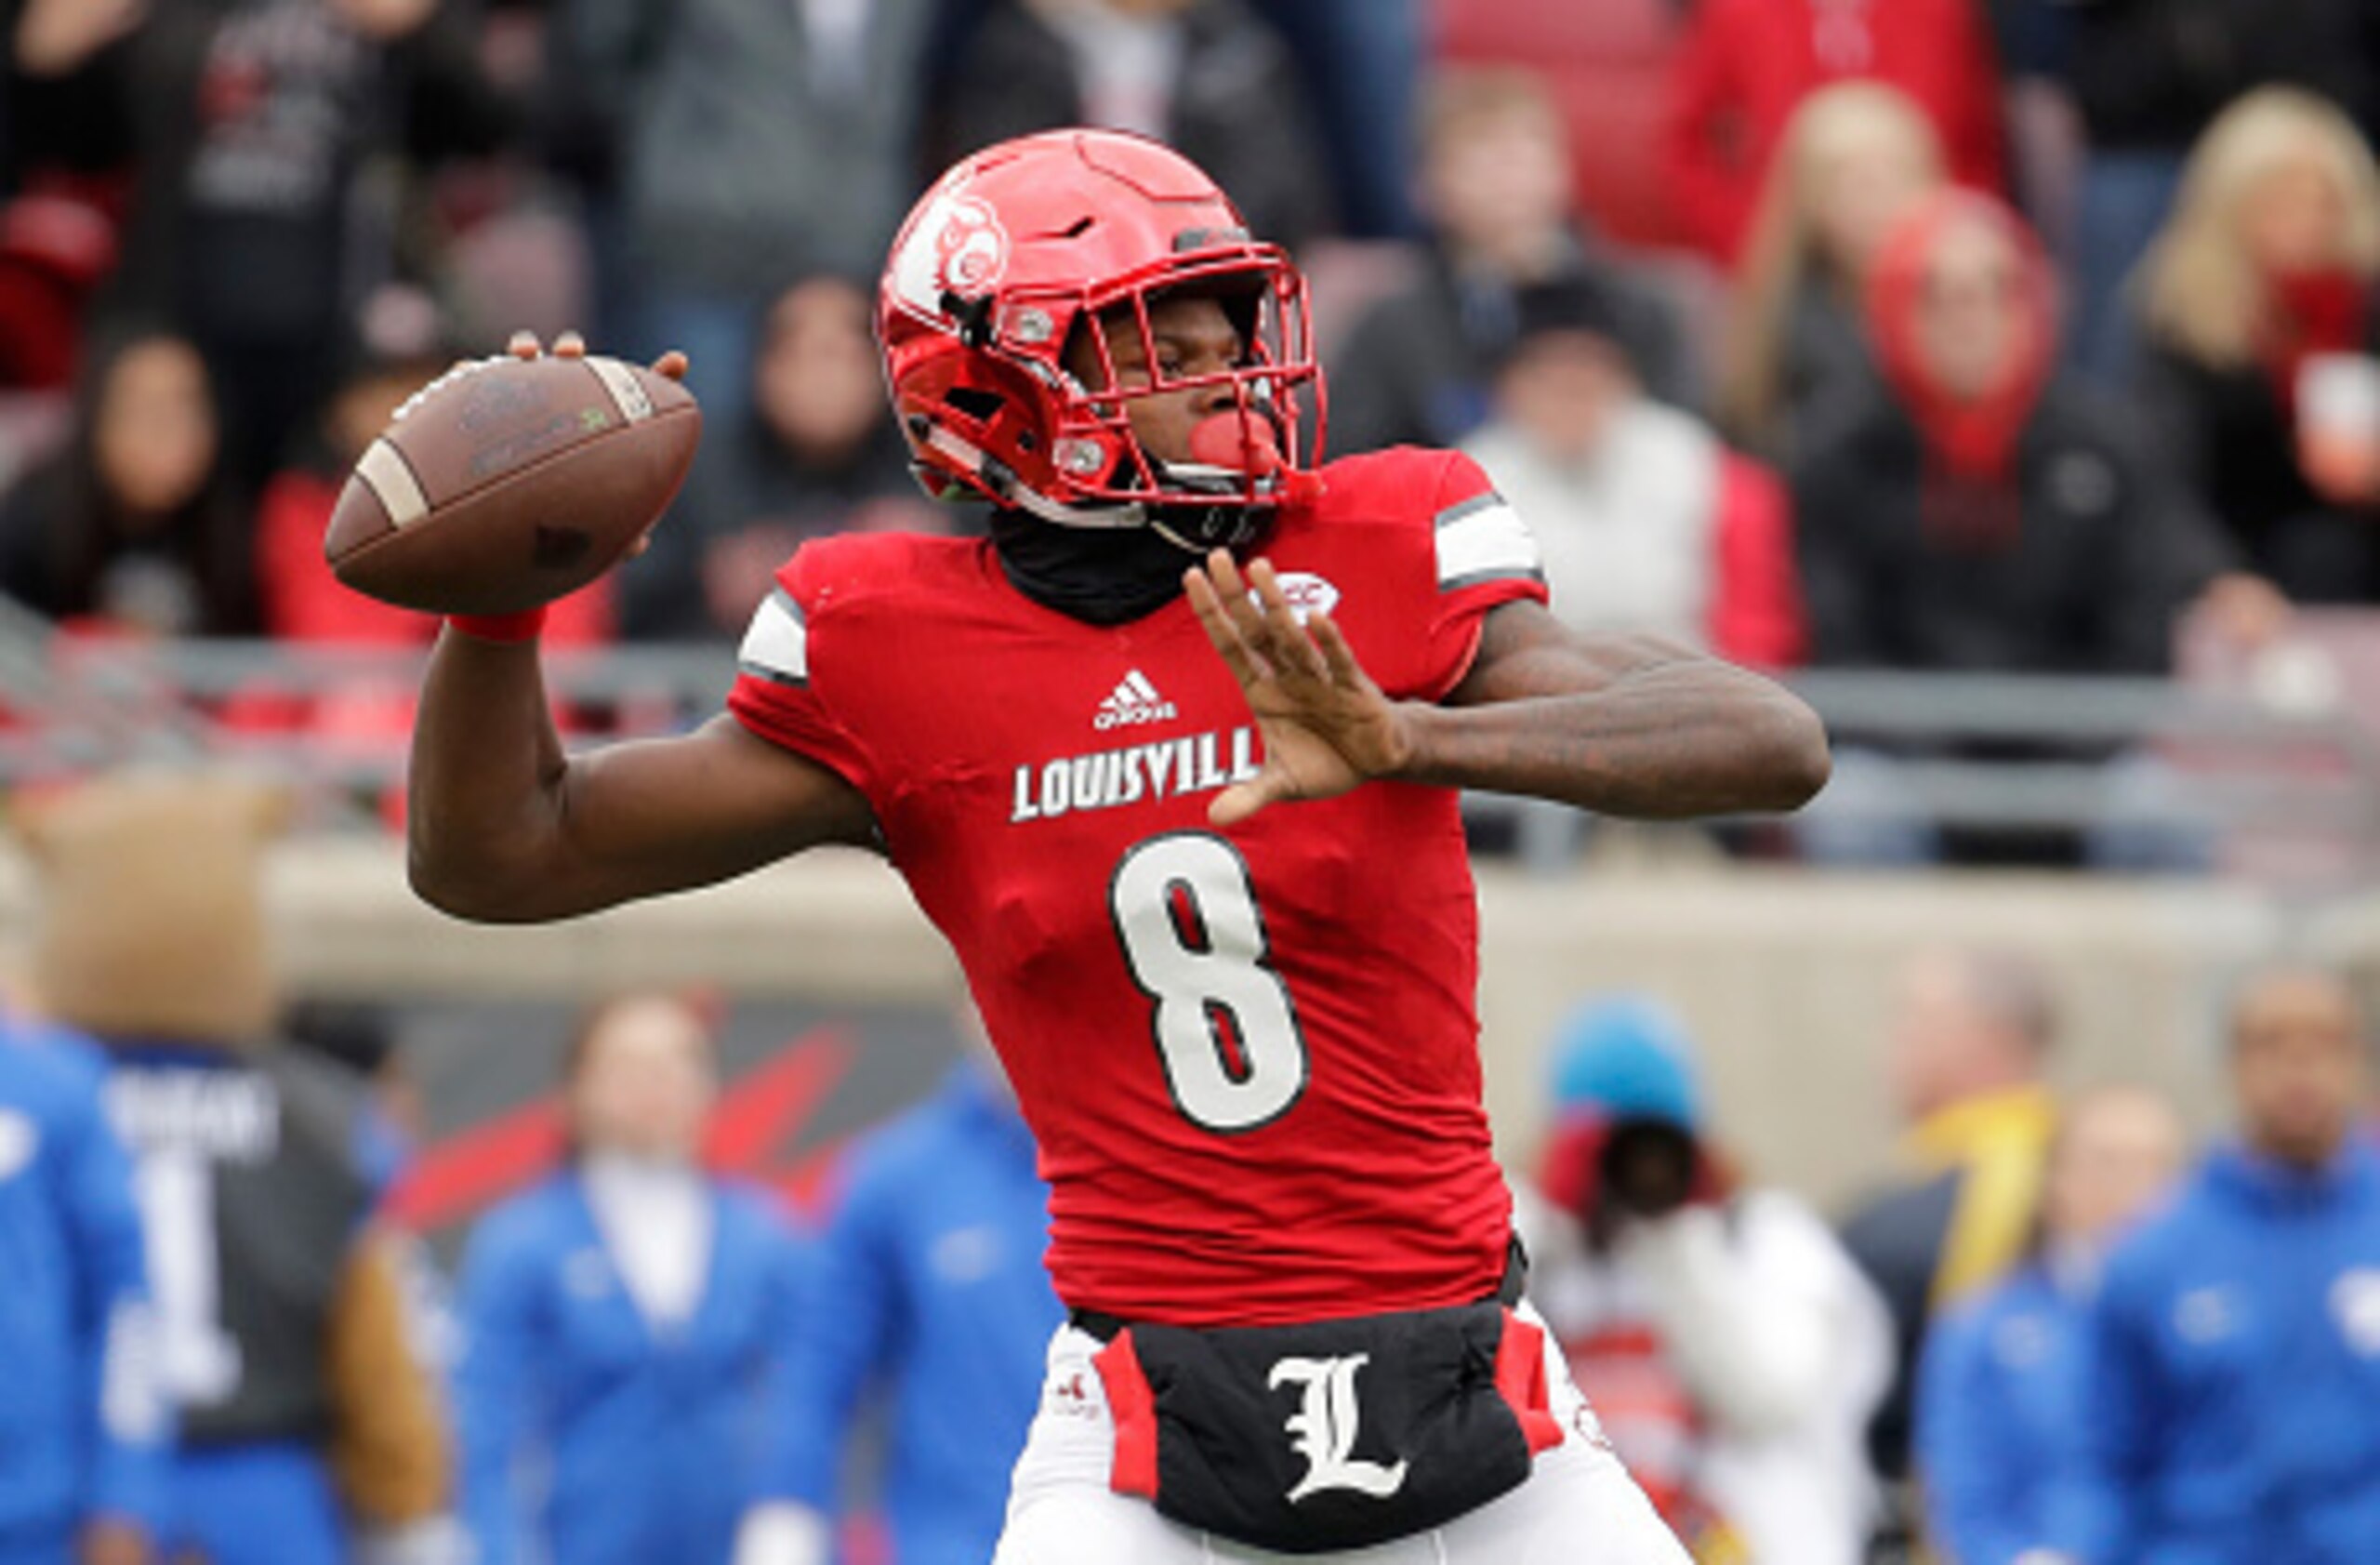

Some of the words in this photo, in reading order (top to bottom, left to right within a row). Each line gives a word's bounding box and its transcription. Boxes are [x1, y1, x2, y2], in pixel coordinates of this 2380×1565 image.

[1010, 725, 1263, 823] LOUISVILL
[1106, 828, 1312, 1134] 8
[1268, 1352, 1409, 1504] L
